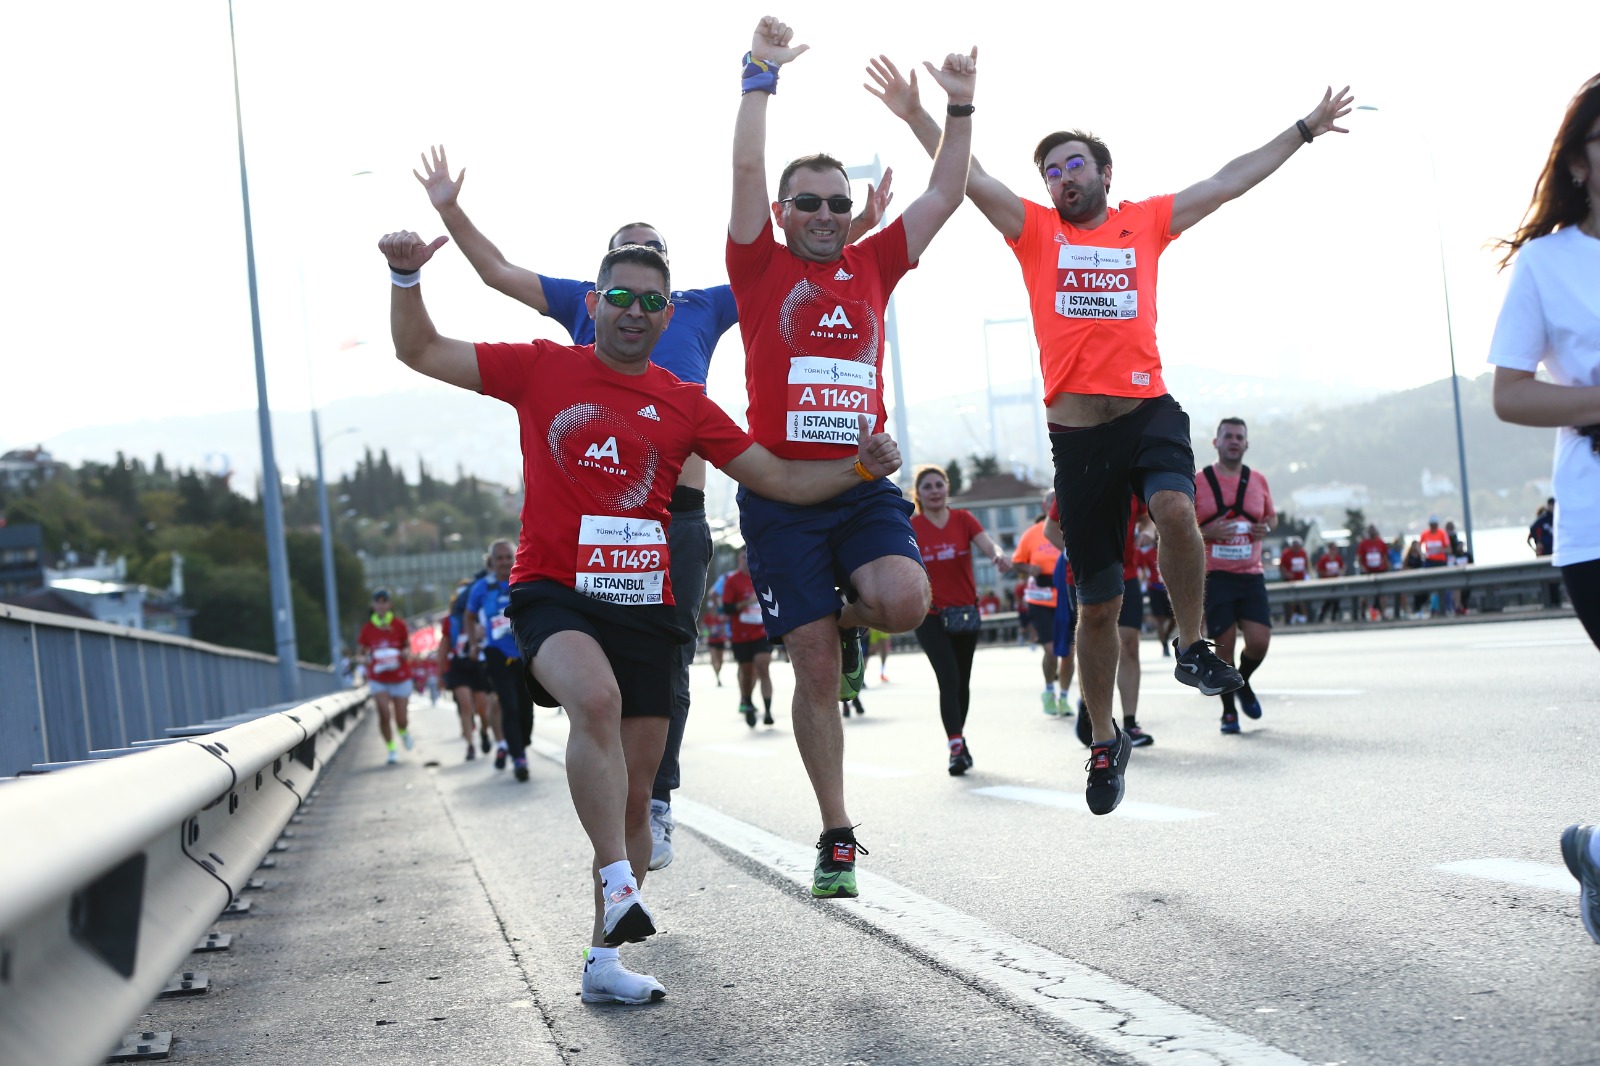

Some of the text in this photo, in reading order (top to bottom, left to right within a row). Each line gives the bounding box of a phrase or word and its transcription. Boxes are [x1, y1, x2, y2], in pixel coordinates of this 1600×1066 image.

[1063, 271, 1129, 290] A 11490
[1069, 295, 1118, 307] ISTANBUL
[1067, 307, 1118, 317] MARATHON
[810, 330, 834, 339] ADIM
[804, 367, 831, 375] TÜRKİYE
[798, 386, 868, 411] A 11491
[803, 415, 859, 430] ISTANBUL
[801, 429, 859, 443] MARATHON
[577, 459, 627, 476] ADIM ADIM
[596, 528, 623, 536] TÜRKİYE
[587, 547, 660, 569] A 11493
[593, 576, 645, 590] ISTANBUL
[590, 591, 645, 603] MARATHON
